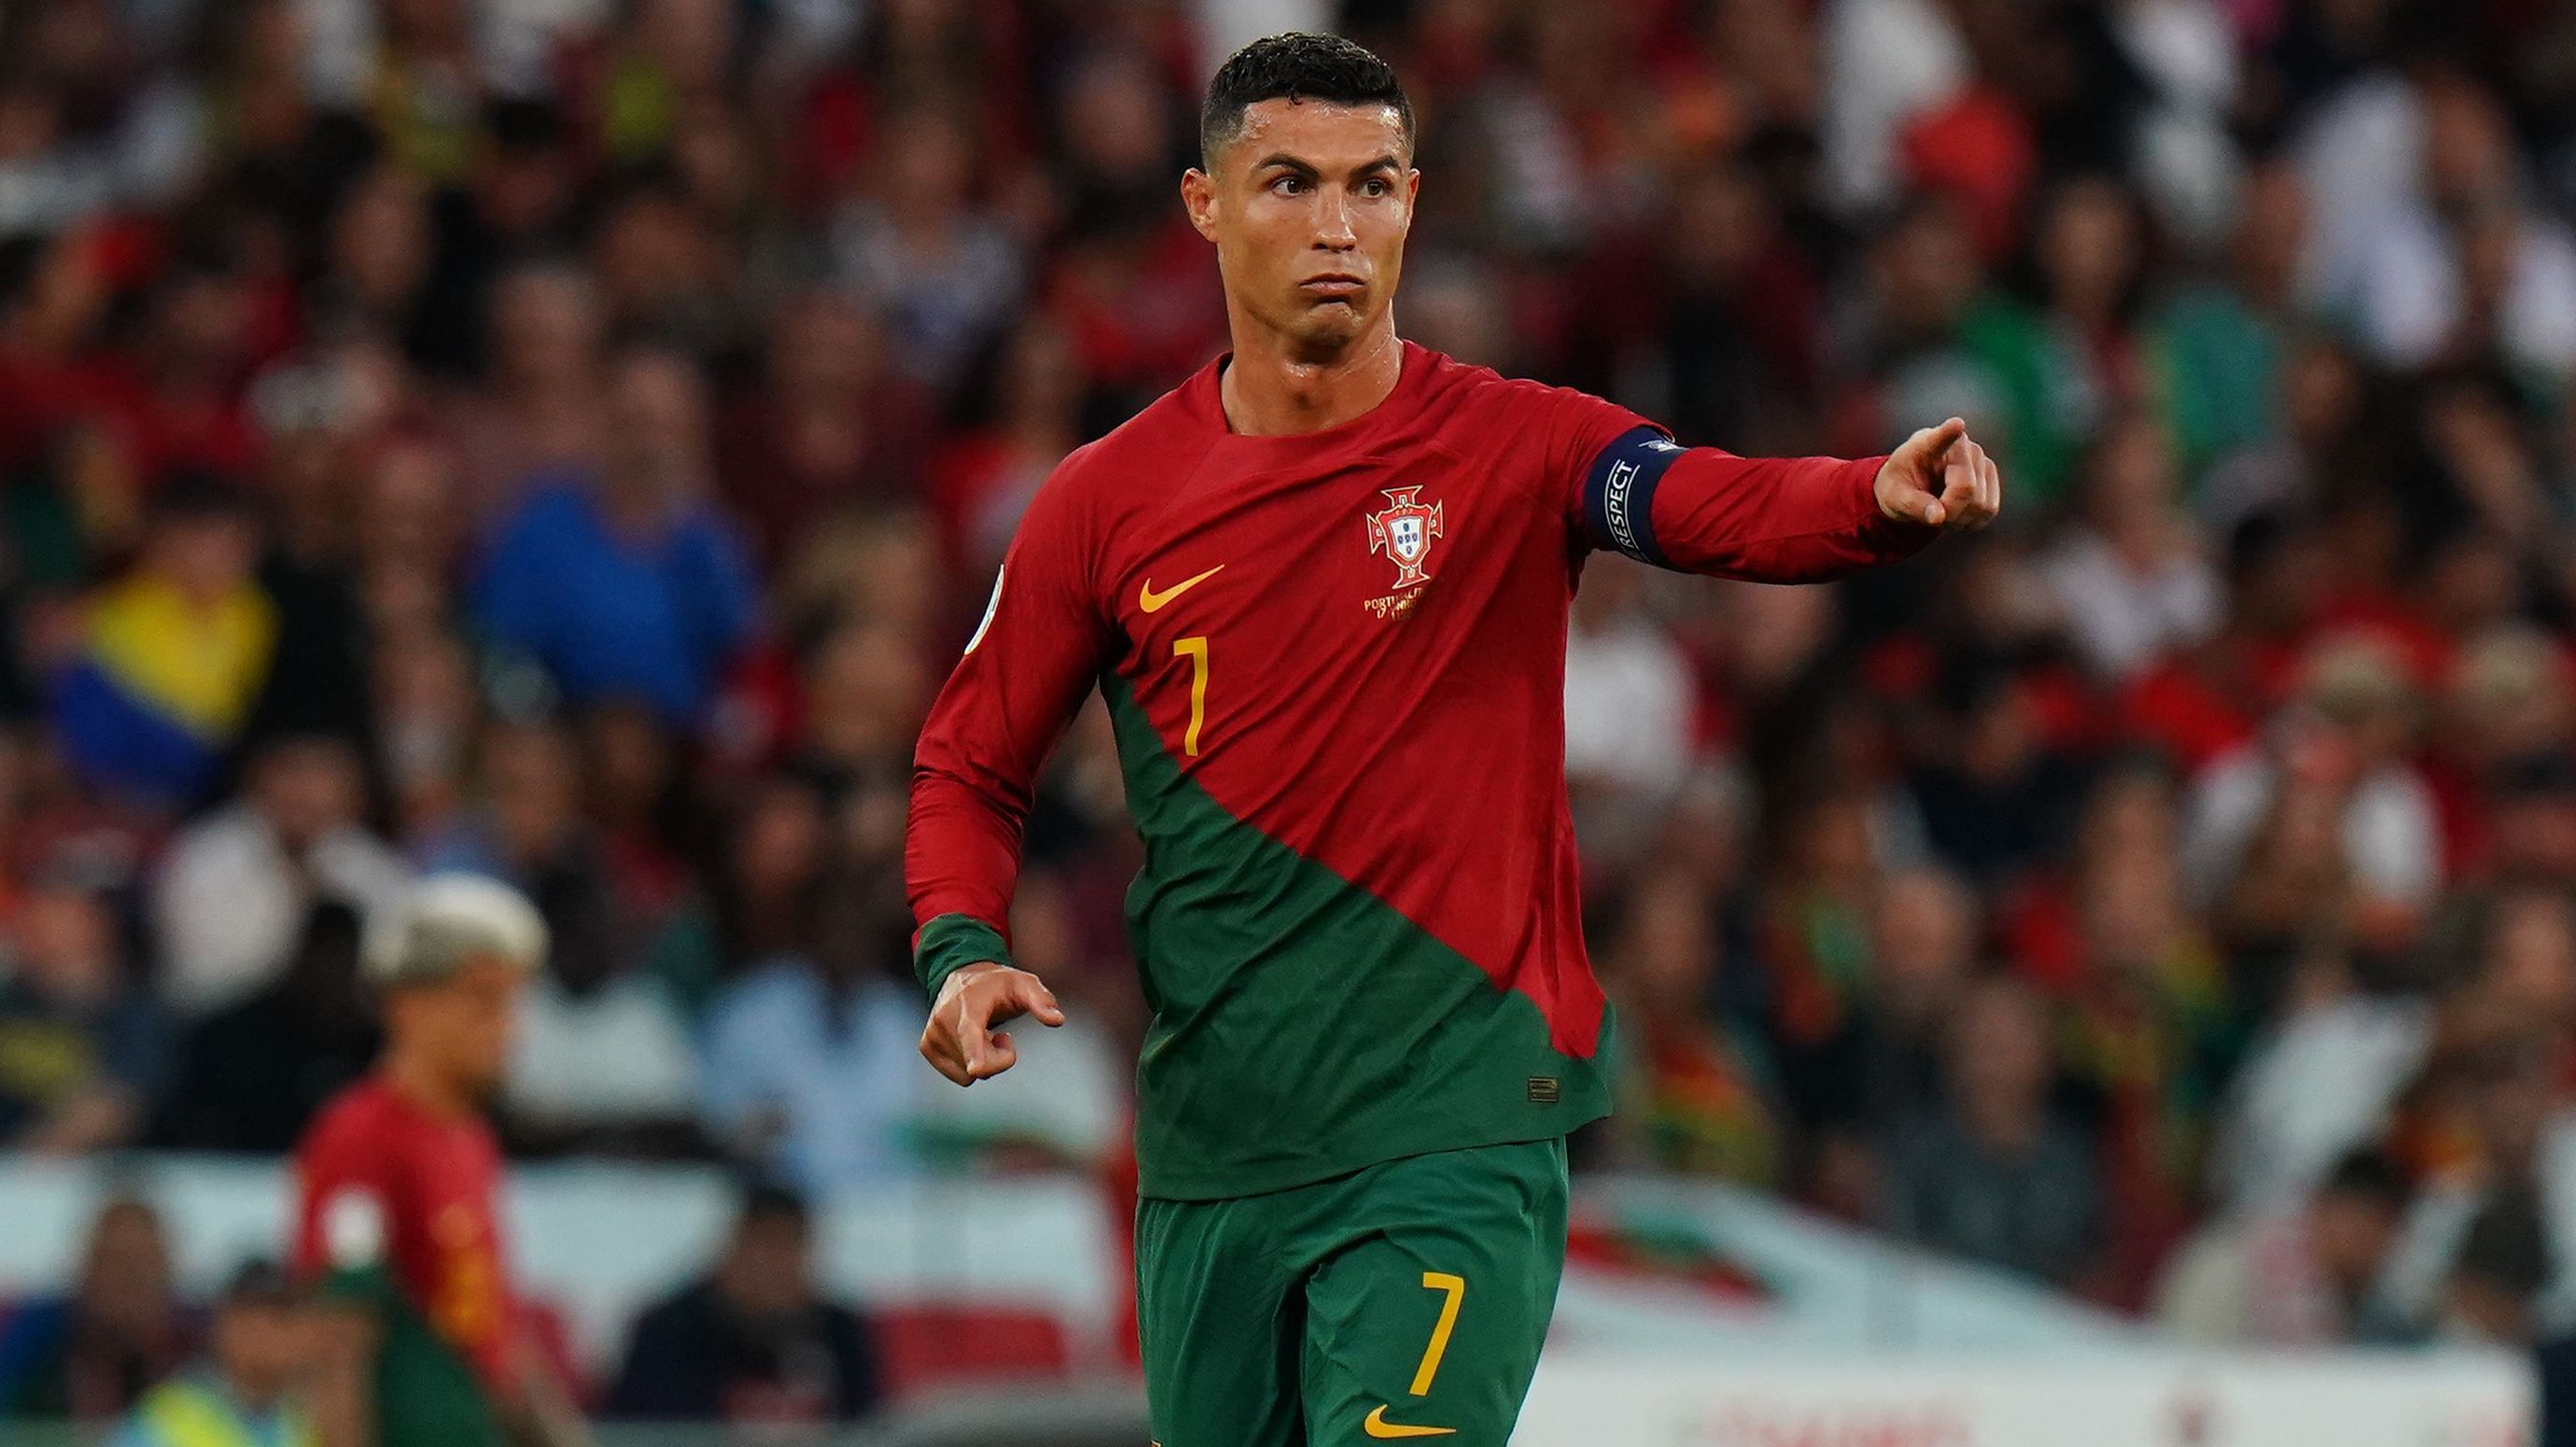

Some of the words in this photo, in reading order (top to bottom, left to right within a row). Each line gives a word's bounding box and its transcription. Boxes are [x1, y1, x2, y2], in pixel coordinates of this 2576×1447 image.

[1610, 460, 1634, 548] RESPECT
[1173, 636, 1209, 756] 7
[1409, 1271, 1464, 1397] 7
